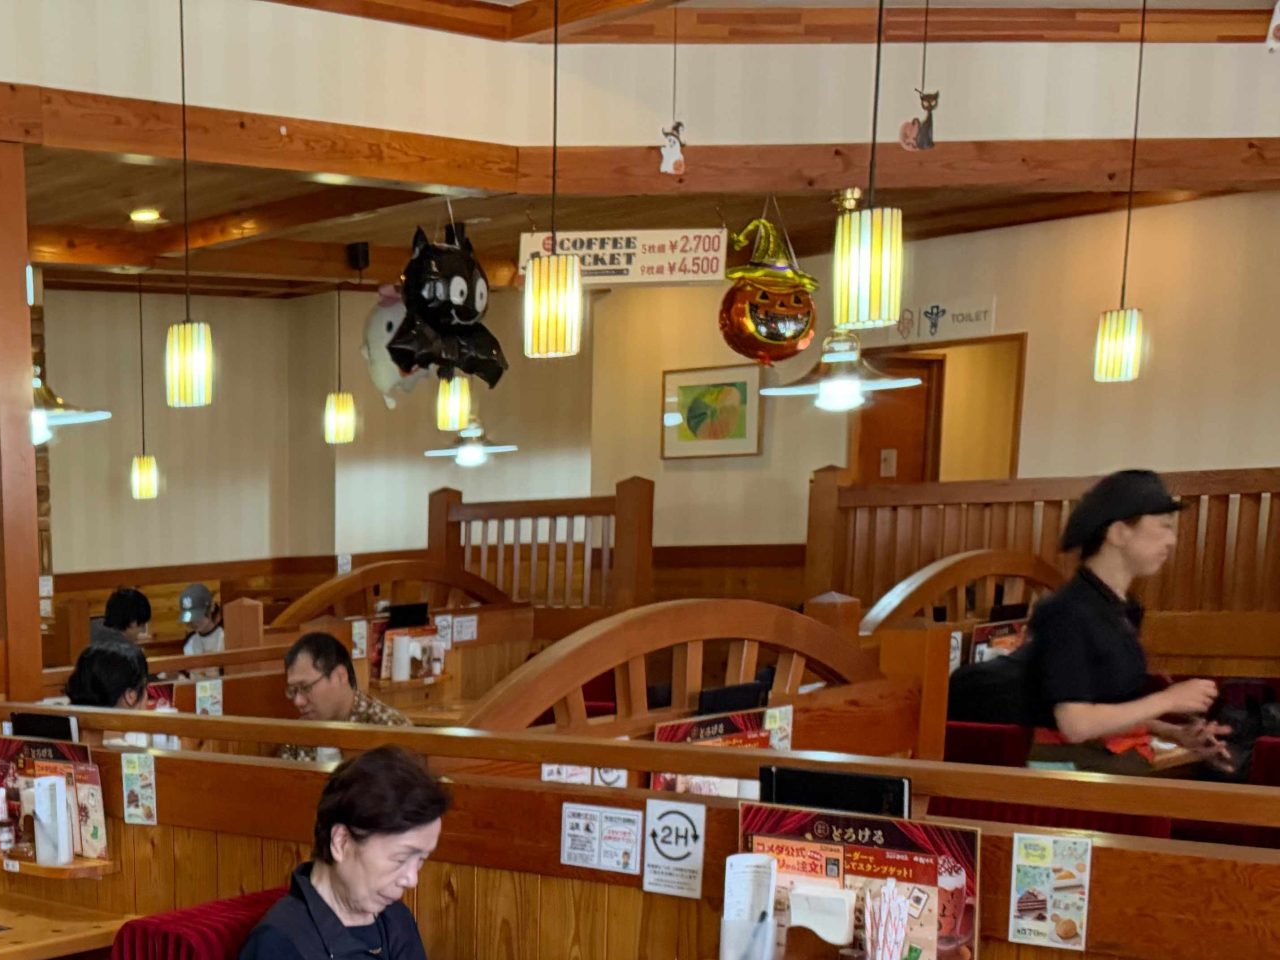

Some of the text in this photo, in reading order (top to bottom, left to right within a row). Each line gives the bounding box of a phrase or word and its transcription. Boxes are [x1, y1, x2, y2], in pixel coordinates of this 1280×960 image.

[559, 236, 637, 251] COFFEE
[951, 310, 989, 323] TOILET
[660, 825, 688, 847] 2H
[831, 825, 885, 845] とろける
